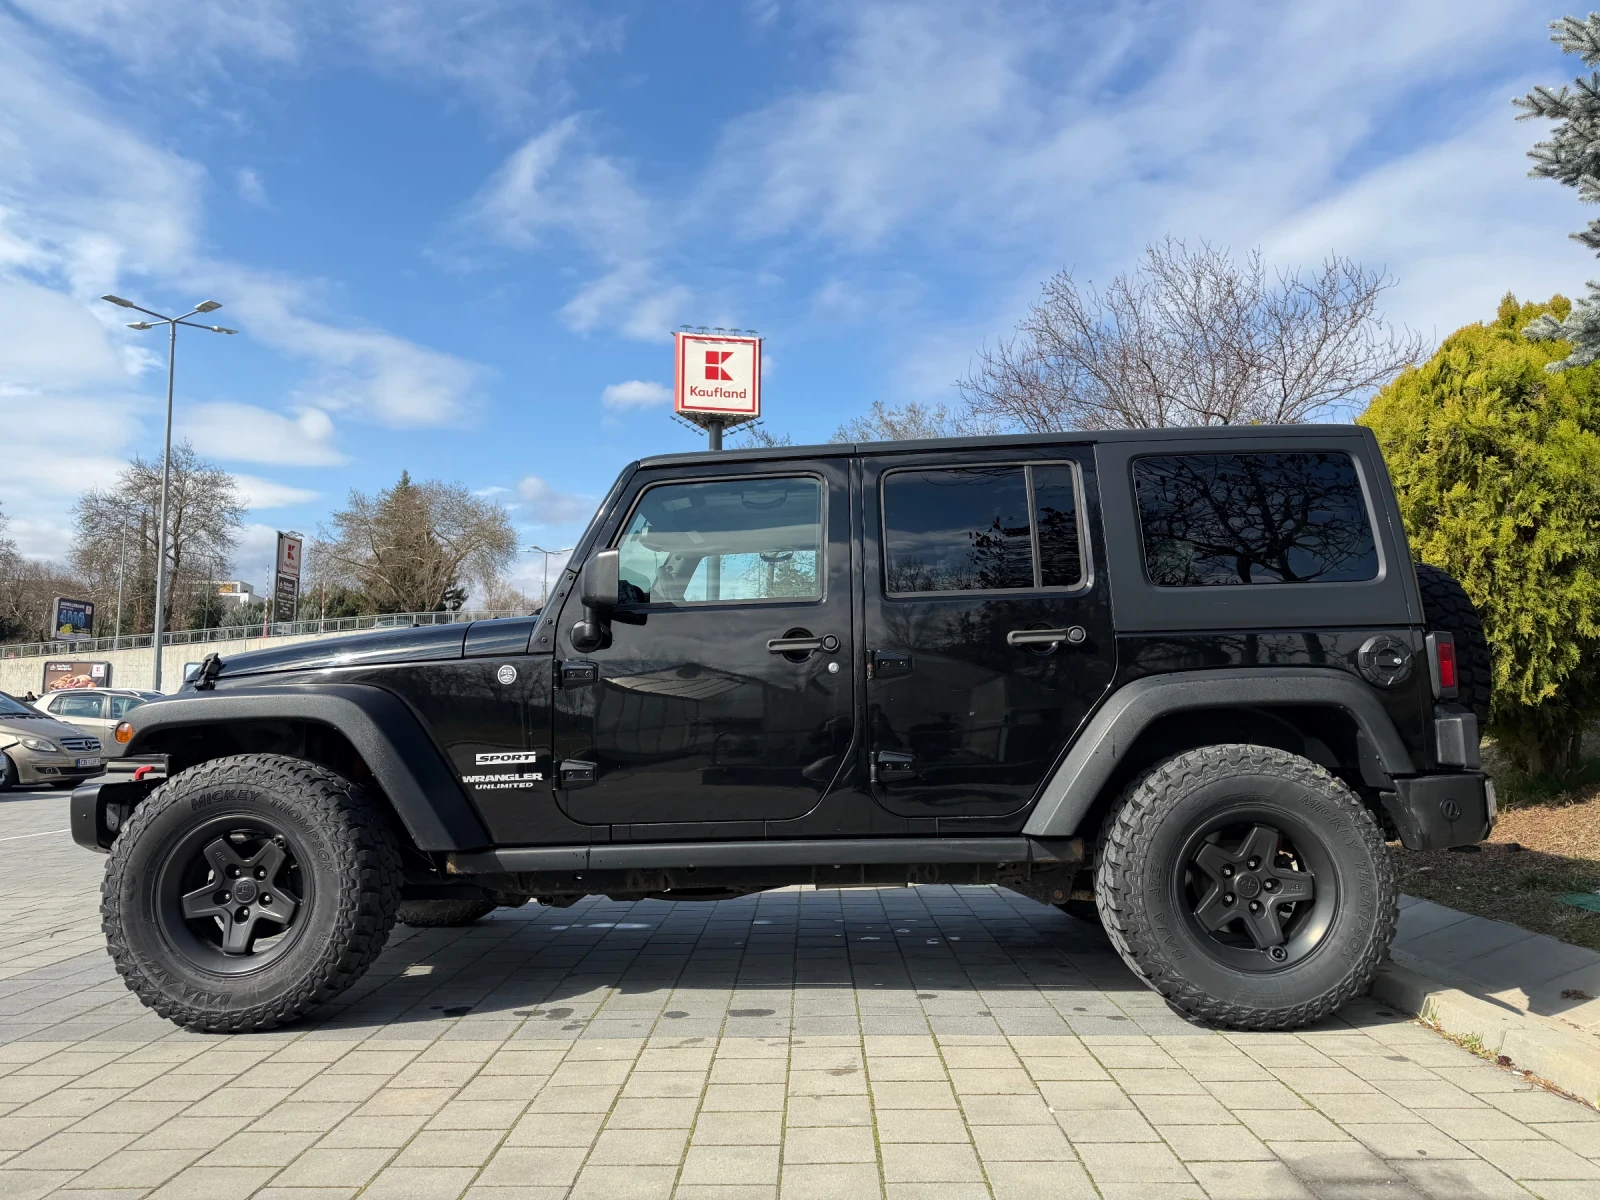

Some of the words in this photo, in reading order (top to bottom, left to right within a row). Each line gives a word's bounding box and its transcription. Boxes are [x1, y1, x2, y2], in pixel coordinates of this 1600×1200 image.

[705, 351, 734, 381] K
[690, 386, 747, 398] Kaufland
[478, 754, 533, 763] SPORT
[462, 773, 543, 783] WRANGLER
[475, 782, 534, 790] UNLIMITED
[191, 789, 263, 811] MICKEY
[269, 797, 334, 875] THOMPSON
[1300, 793, 1362, 850] MICKEY
[1341, 861, 1373, 966] THOMPSON
[1153, 912, 1187, 961] BAJA
[143, 961, 181, 986] ATZ
[182, 986, 233, 1007] BAJA
